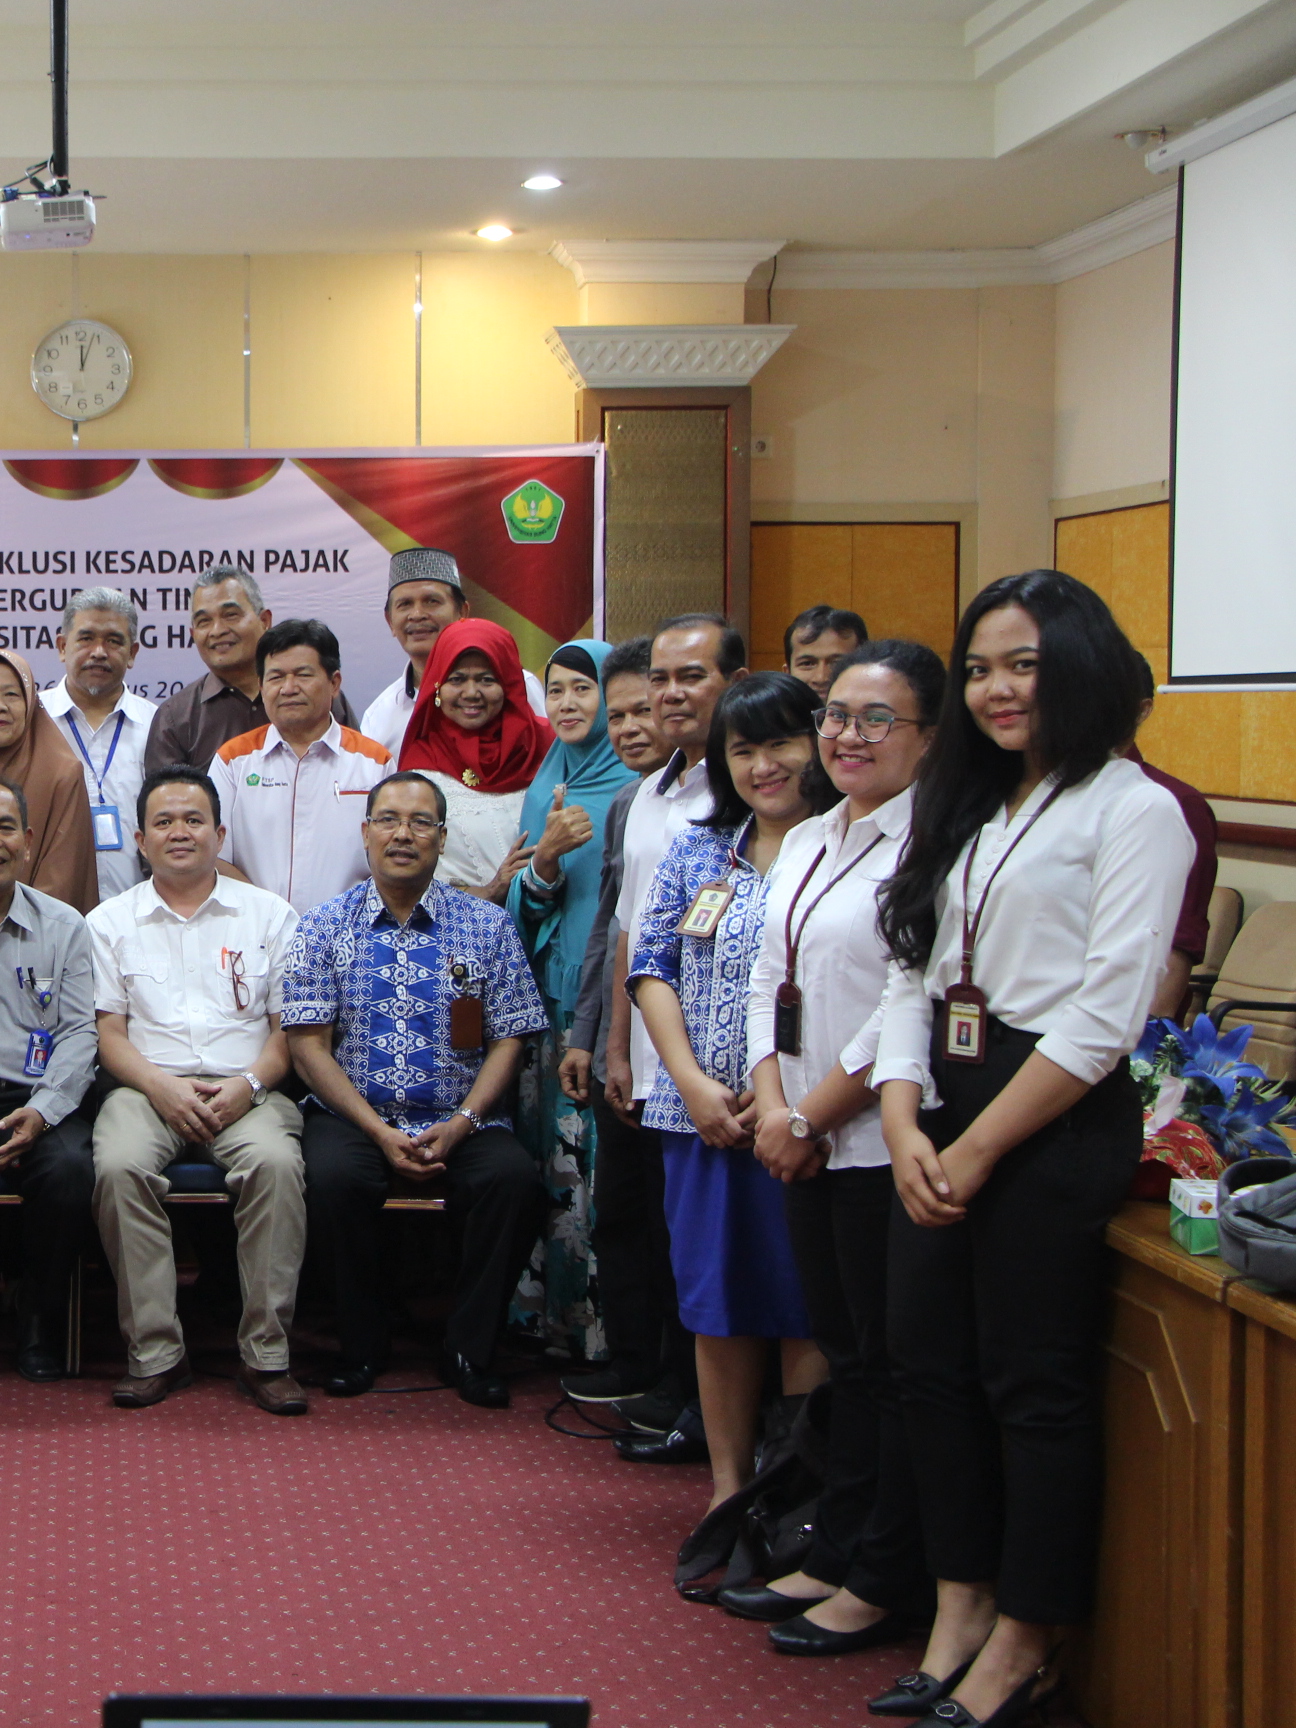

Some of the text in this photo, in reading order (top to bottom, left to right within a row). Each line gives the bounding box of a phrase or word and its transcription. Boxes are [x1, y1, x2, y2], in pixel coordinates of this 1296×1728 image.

[60, 335, 69, 345] 11
[75, 331, 87, 341] 12
[97, 334, 101, 344] 1
[46, 349, 59, 359] 10
[106, 346, 115, 357] 2
[43, 365, 53, 376] 9
[111, 364, 121, 375] 3
[48, 382, 58, 393] 8
[106, 381, 115, 391] 4
[62, 394, 71, 405] 7
[77, 398, 87, 409] 6
[94, 394, 104, 405] 5
[85, 550, 254, 575] KESADARAN
[264, 549, 350, 574] PAJAK
